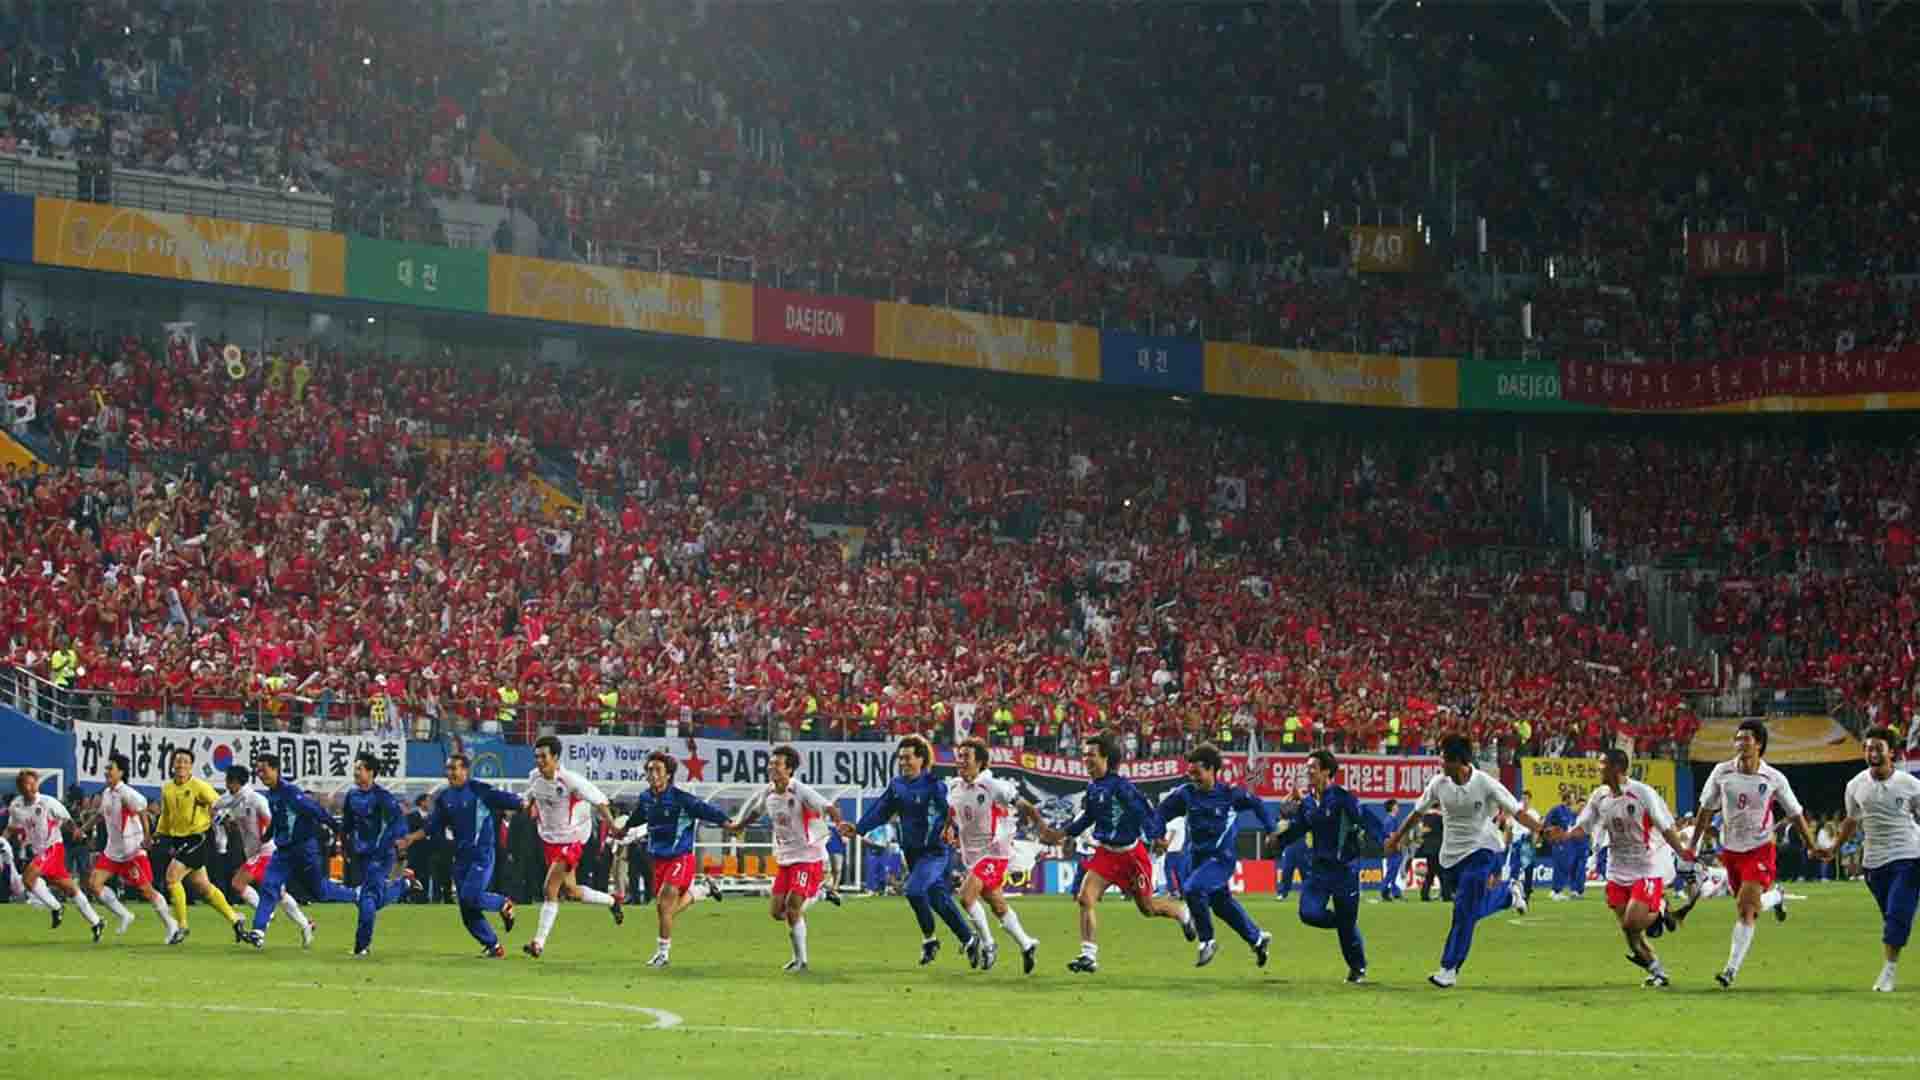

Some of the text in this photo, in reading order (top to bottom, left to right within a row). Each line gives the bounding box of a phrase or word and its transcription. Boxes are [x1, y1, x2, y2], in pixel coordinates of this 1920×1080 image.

[784, 304, 844, 337] DAEJEON
[569, 744, 606, 763] Enjoy
[716, 748, 770, 783] PAR
[802, 751, 823, 784] JI
[1022, 751, 1088, 774] GUAR
